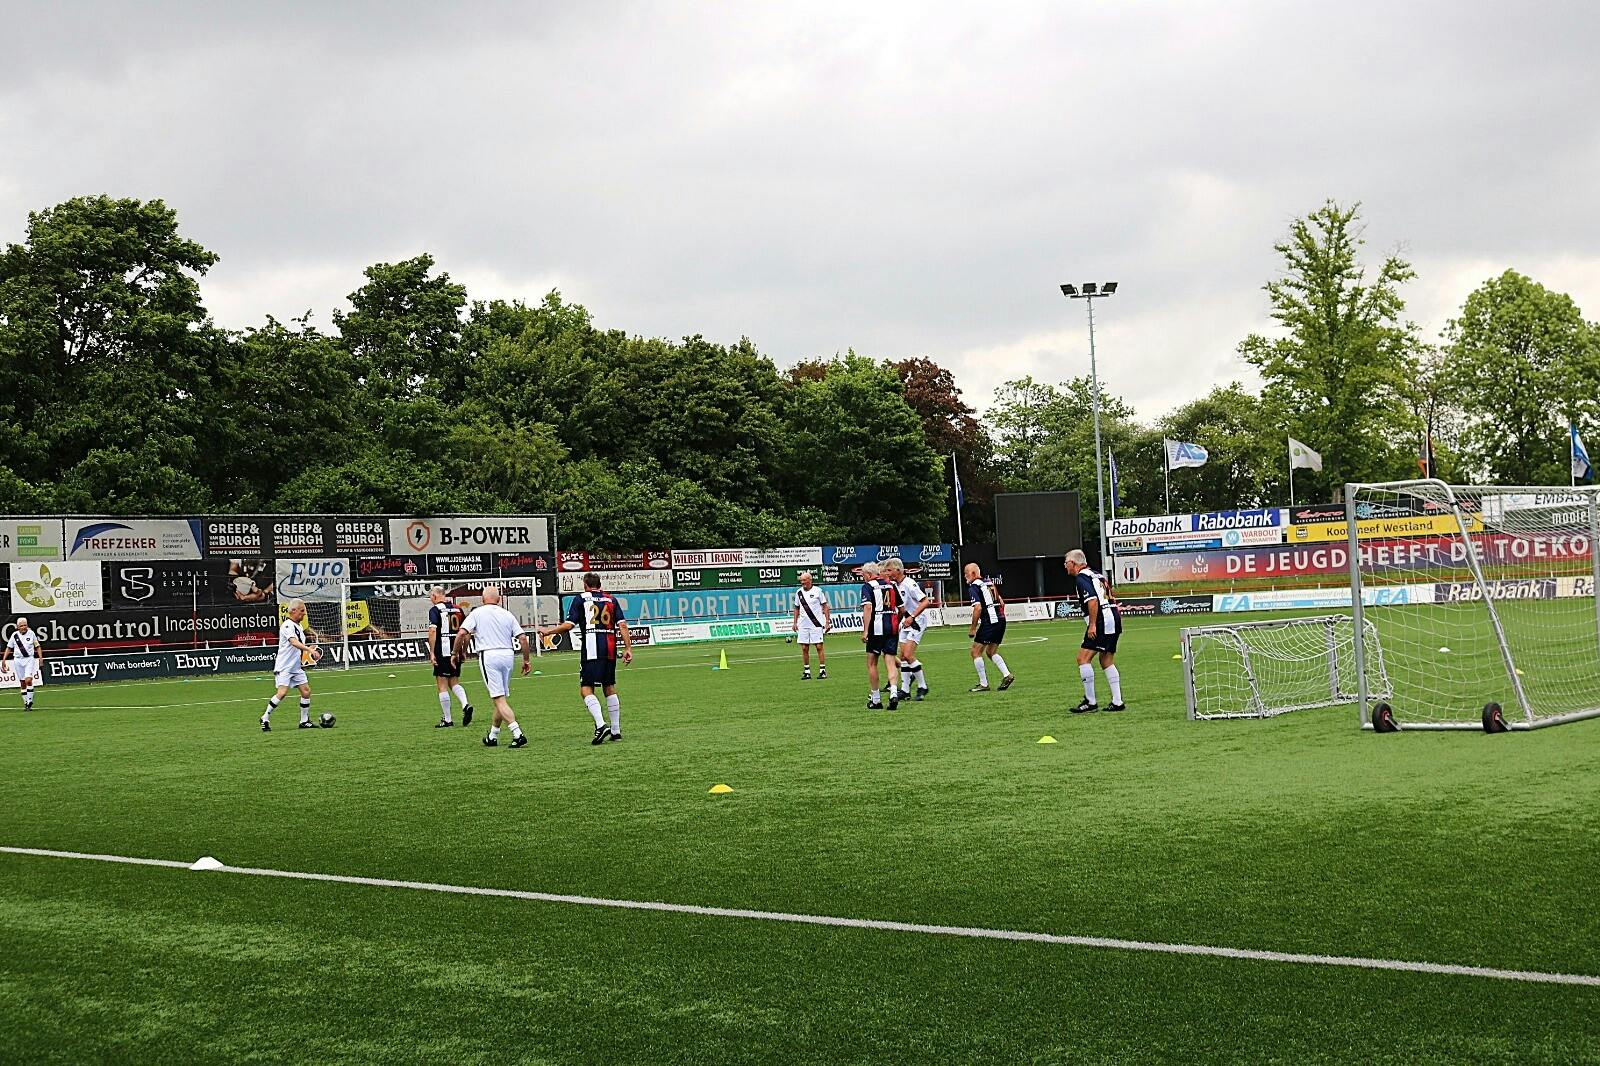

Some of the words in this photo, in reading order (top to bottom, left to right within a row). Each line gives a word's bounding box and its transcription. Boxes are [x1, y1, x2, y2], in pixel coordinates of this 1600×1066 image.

[1199, 510, 1273, 529] Rabobank
[208, 523, 260, 534] GREEP&
[273, 523, 323, 534] GREEP&
[336, 522, 383, 533] GREEP&
[1112, 519, 1182, 535] Rabobank
[1383, 521, 1433, 533] Westland
[283, 534, 324, 545] BURGH
[345, 534, 384, 544] BURGH
[440, 527, 530, 545] B-POWER
[1241, 530, 1278, 539] WARBOUT
[84, 538, 157, 550] TREFZEKER
[219, 535, 260, 546] BURGH
[674, 553, 707, 564] WILBERT
[711, 551, 742, 563] TRADING
[1226, 554, 1257, 574] DE
[1266, 549, 1347, 572] JEUGD
[1359, 543, 1438, 566] HEEFT
[1450, 541, 1484, 561] DE
[1494, 534, 1589, 558] TOEKO
[288, 561, 344, 586] Euro
[759, 569, 780, 578] DSW
[1192, 563, 1209, 574] bud
[305, 577, 350, 586] PRODUCTS
[677, 571, 700, 581] DSW
[66, 581, 86, 590] Total
[468, 581, 507, 590] HOUTEN
[509, 579, 542, 589] GEVES
[54, 588, 84, 598] Green
[1374, 588, 1409, 604] EA
[1448, 580, 1541, 601] Rabobank
[68, 598, 98, 609] Europe
[1220, 596, 1250, 611] EA
[589, 604, 611, 625] 26
[1, 616, 161, 643] Cshcontrol
[165, 613, 277, 632] Incassodiensten
[709, 623, 771, 637] GROENEVELD
[330, 645, 366, 662] VAN
[368, 641, 425, 660] KESSEL
[175, 653, 220, 671] Ebury
[225, 655, 245, 663] What
[246, 653, 277, 662] borders?
[49, 660, 99, 679] Ebury
[105, 660, 125, 670] What
[127, 659, 161, 669] borders?
